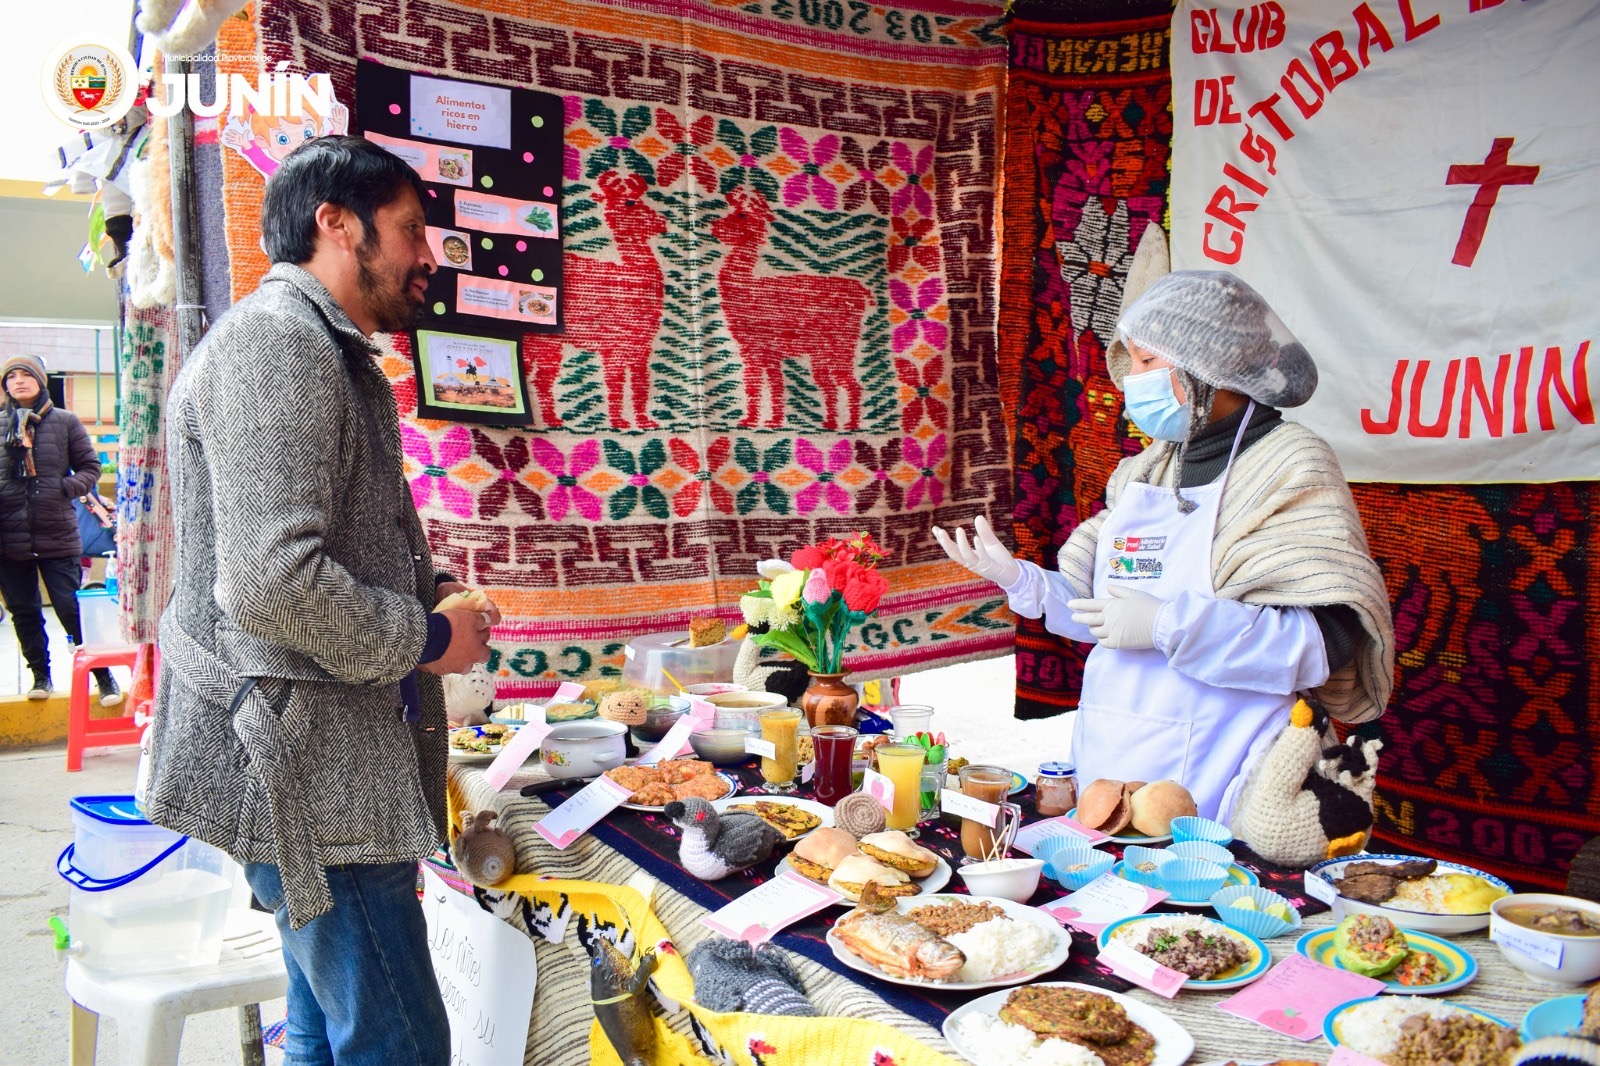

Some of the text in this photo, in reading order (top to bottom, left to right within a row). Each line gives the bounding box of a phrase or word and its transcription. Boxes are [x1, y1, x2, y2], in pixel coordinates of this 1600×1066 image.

[1190, 1, 1286, 54] CLUB
[436, 95, 486, 110] Alimentos
[441, 109, 465, 118] ricos
[446, 119, 478, 131] hierro
[1194, 75, 1242, 127] DE
[1202, 0, 1441, 266] CRISTOBAL
[1361, 340, 1596, 438] JUNIN
